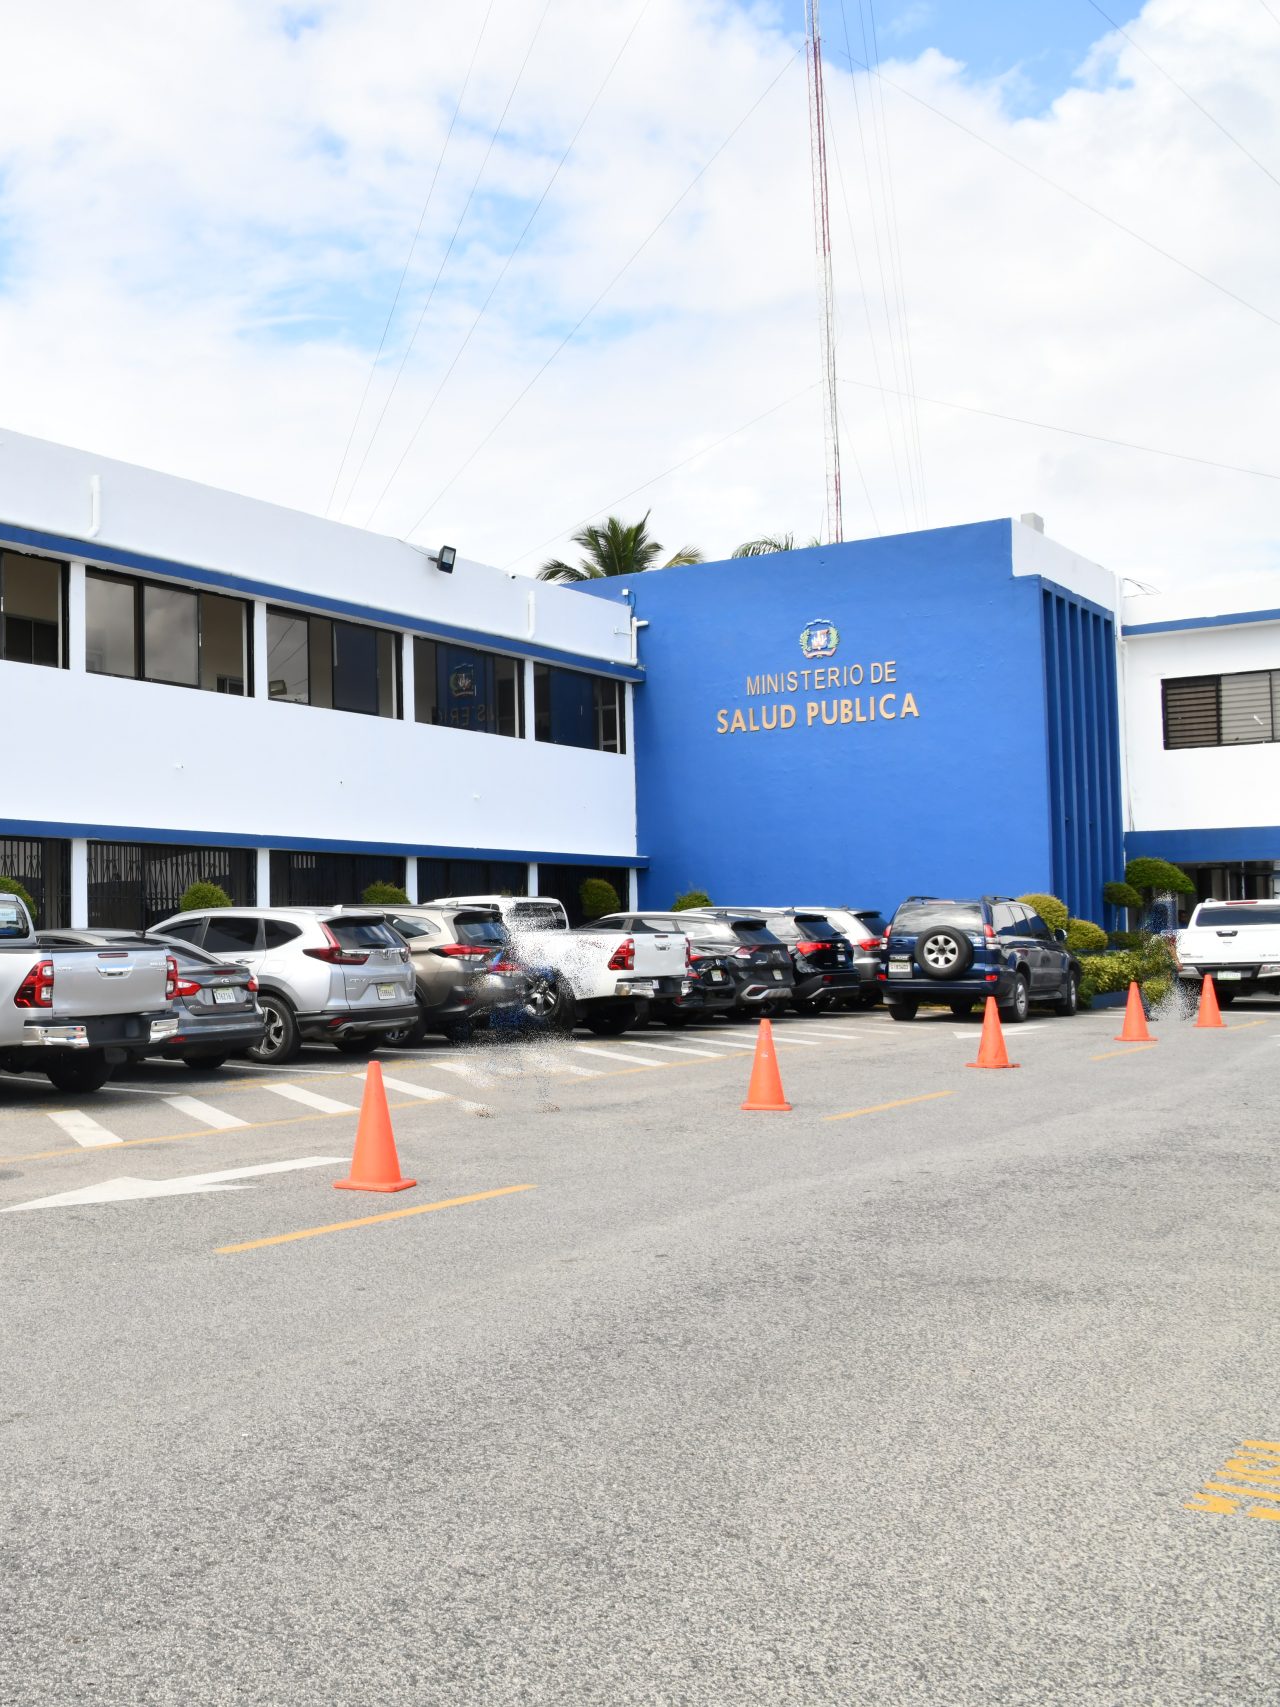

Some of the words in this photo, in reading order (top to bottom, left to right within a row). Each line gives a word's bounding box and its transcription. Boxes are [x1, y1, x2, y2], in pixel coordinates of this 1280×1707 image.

[746, 664, 864, 696] MINISTERIO
[870, 661, 897, 684] DE
[716, 704, 796, 734] SALUD
[807, 692, 920, 727] PUBLICA
